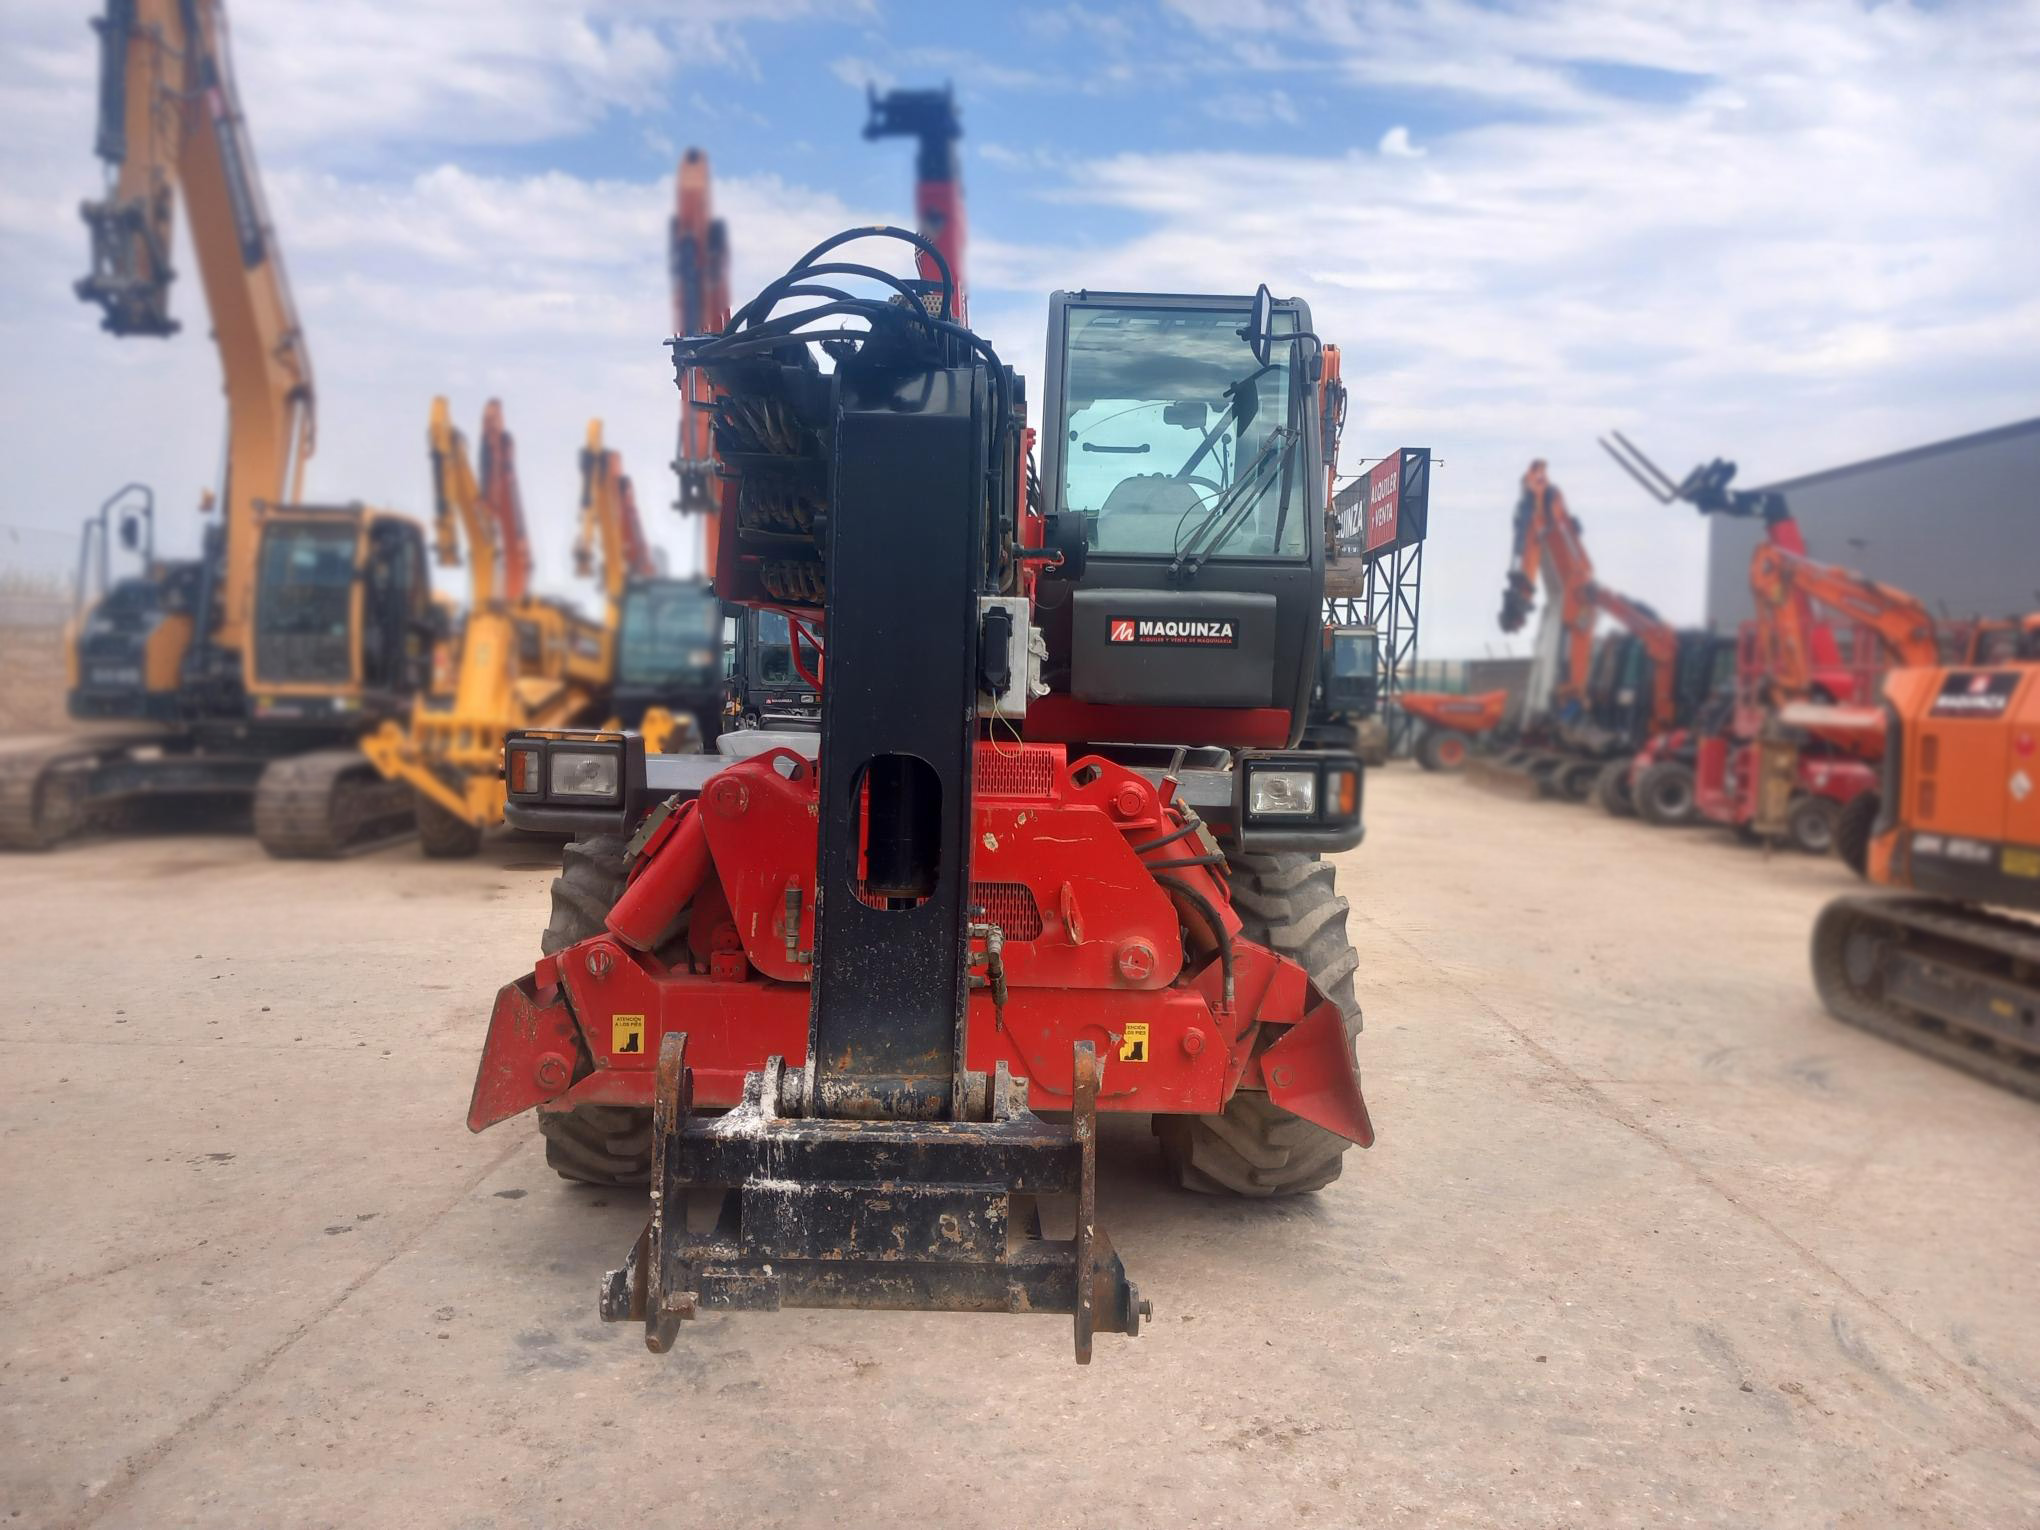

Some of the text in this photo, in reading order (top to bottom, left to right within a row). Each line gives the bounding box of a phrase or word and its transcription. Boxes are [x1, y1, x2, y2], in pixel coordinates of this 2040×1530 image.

[1371, 471, 1397, 505] ALQUILER
[1376, 501, 1392, 528] VENTA
[1139, 621, 1233, 637] MAQUINZA
